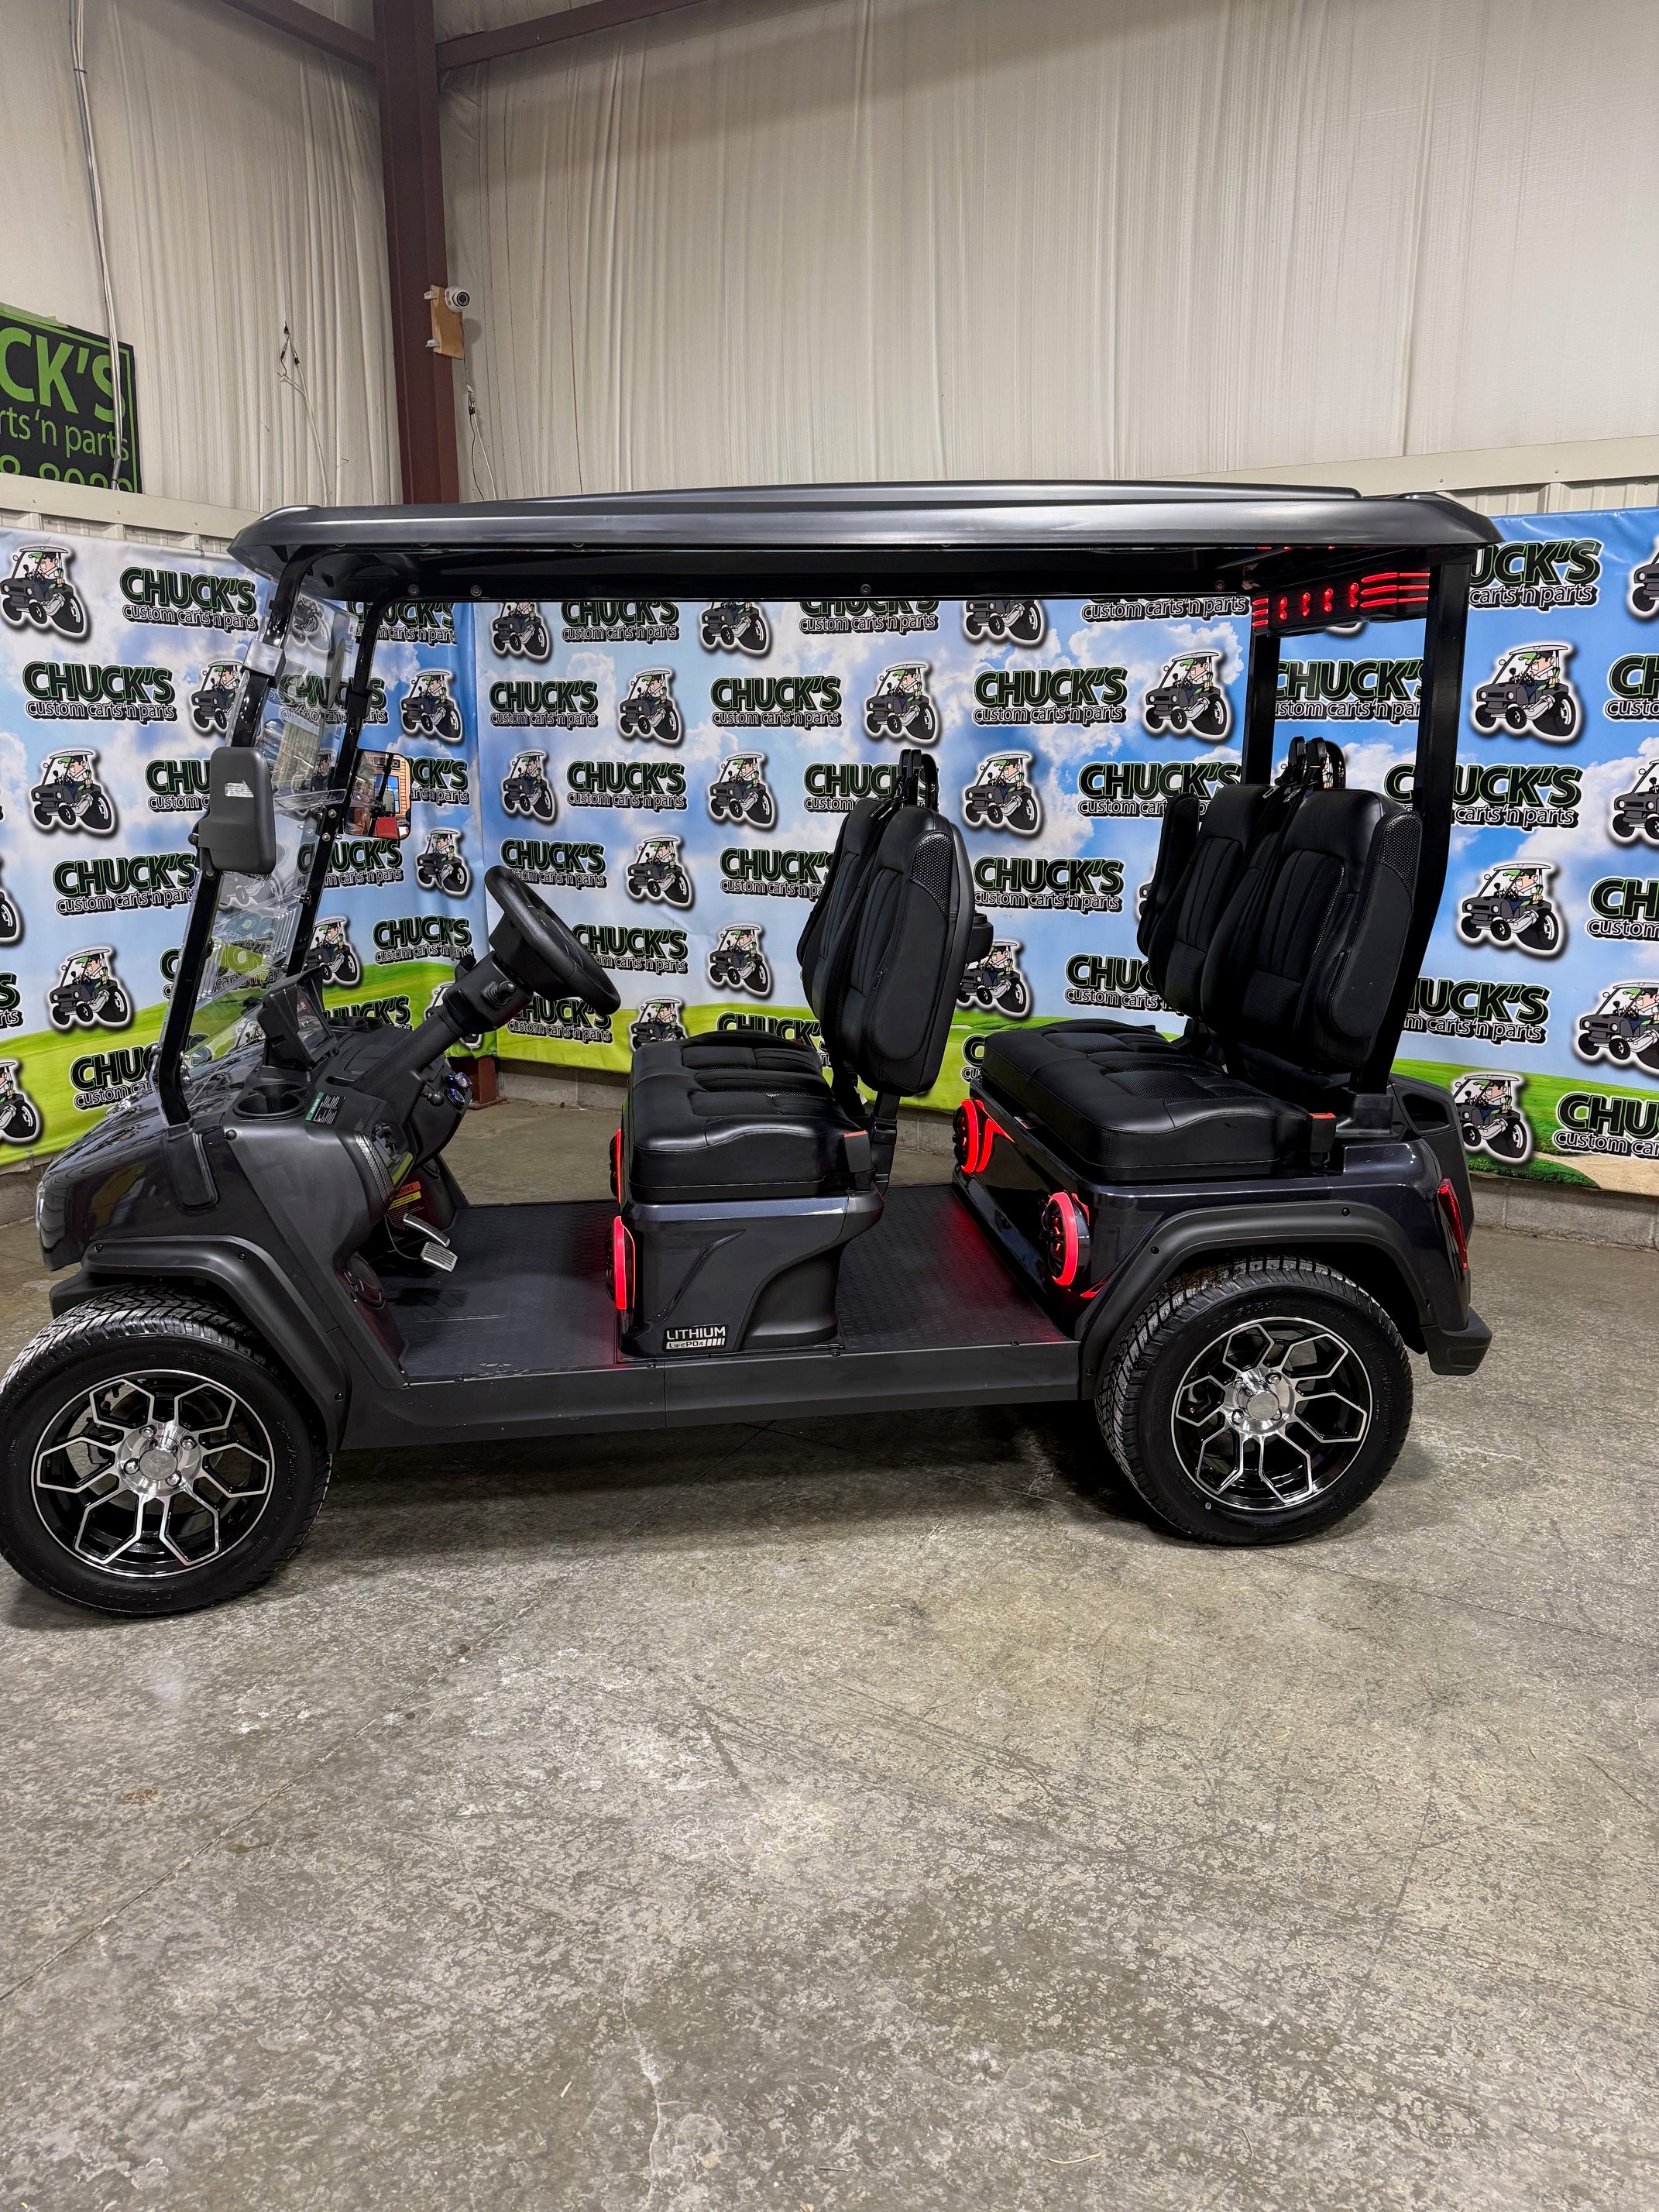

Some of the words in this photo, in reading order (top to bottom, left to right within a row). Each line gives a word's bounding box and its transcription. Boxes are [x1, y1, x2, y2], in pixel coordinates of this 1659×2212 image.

[1471, 540, 1602, 586] UCK'S
[120, 567, 257, 614] CHUCK'S
[1539, 585, 1592, 610] parts
[122, 605, 175, 623] custom
[223, 612, 256, 631] parts
[1082, 602, 1142, 620] custom
[1202, 596, 1247, 619] parts
[562, 626, 604, 641] custom
[647, 623, 677, 642] parts
[799, 617, 850, 632] custom
[899, 613, 936, 634] parts
[22, 661, 175, 703] CHUCK'S
[974, 667, 1128, 708] CHUCK'S
[489, 681, 598, 713] CHUCK'S
[711, 676, 842, 712] CHUCK'S
[26, 700, 85, 717] custom
[139, 703, 174, 722] parts
[712, 710, 759, 725] custom
[804, 710, 840, 728] parts
[974, 705, 1029, 723] custom
[1084, 703, 1123, 725] parts
[1606, 699, 1659, 717] custo
[489, 711, 528, 726] custom
[566, 712, 596, 728] parts
[567, 761, 687, 797] CHUCK'S
[1079, 762, 1242, 800] CHUCK'S
[1384, 764, 1582, 808] CUCK'S
[148, 794, 203, 810] custom
[435, 788, 469, 804] parts
[567, 792, 610, 805] custom
[653, 794, 685, 810] parts
[804, 795, 854, 812] custom
[1078, 799, 1137, 816] custom
[1522, 807, 1575, 829] parts
[501, 839, 606, 874] CHUCK'S
[53, 853, 196, 897] CHUCK'S
[376, 867, 403, 884] parts
[574, 873, 605, 888] parts
[974, 856, 1125, 897] CHUCK'S
[720, 878, 766, 895] custom
[56, 895, 113, 915] custom
[974, 891, 1025, 908] custom
[1080, 894, 1119, 913] parts
[572, 924, 689, 960] CHUCK'S
[375, 946, 413, 963] custom
[654, 959, 687, 974] parts
[1065, 988, 1119, 1006] custom
[507, 1020, 546, 1036] custom
[581, 1029, 612, 1043] parts
[1492, 1021, 1542, 1043] parts
[74, 1084, 129, 1108] custom
[1554, 1131, 1628, 1154] custom
[666, 1326, 726, 1341] LITHIUM
